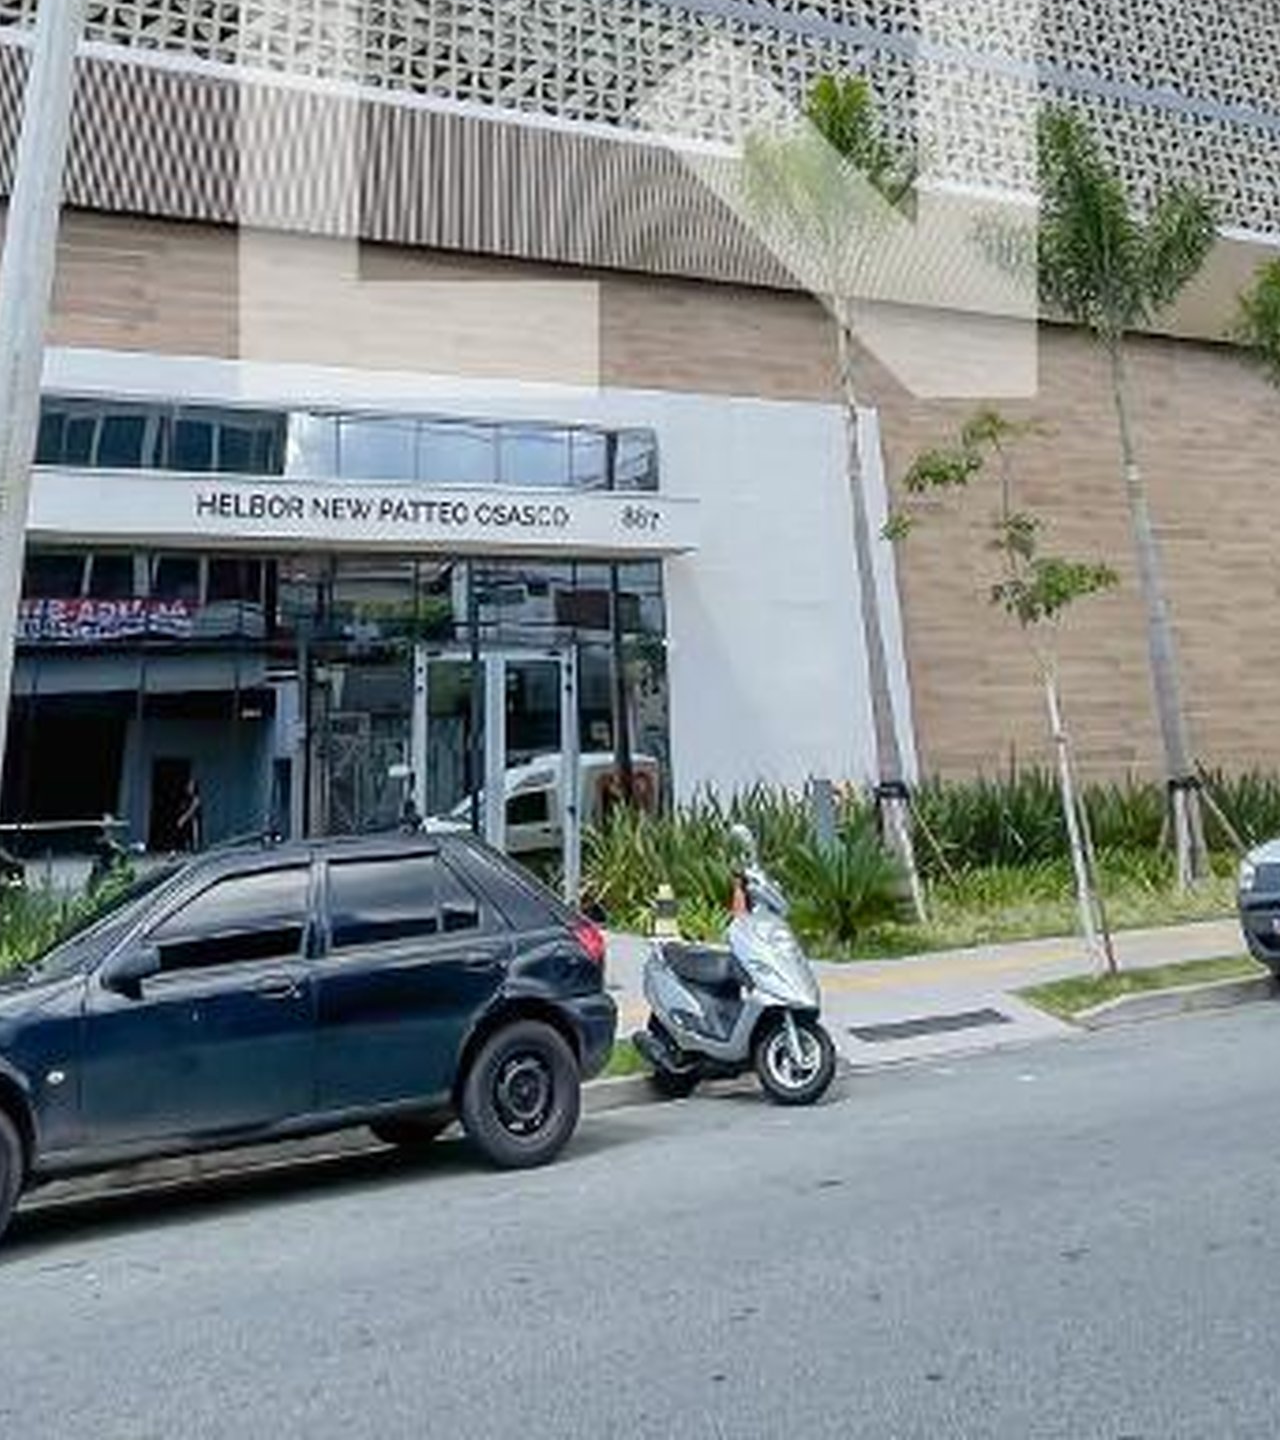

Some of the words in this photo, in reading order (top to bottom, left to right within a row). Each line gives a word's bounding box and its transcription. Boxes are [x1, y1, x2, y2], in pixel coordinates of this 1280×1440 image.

[196, 494, 304, 519] HELBOR
[311, 498, 375, 520] NEW
[376, 498, 469, 525] PATTEO
[474, 504, 570, 527] OSASCO
